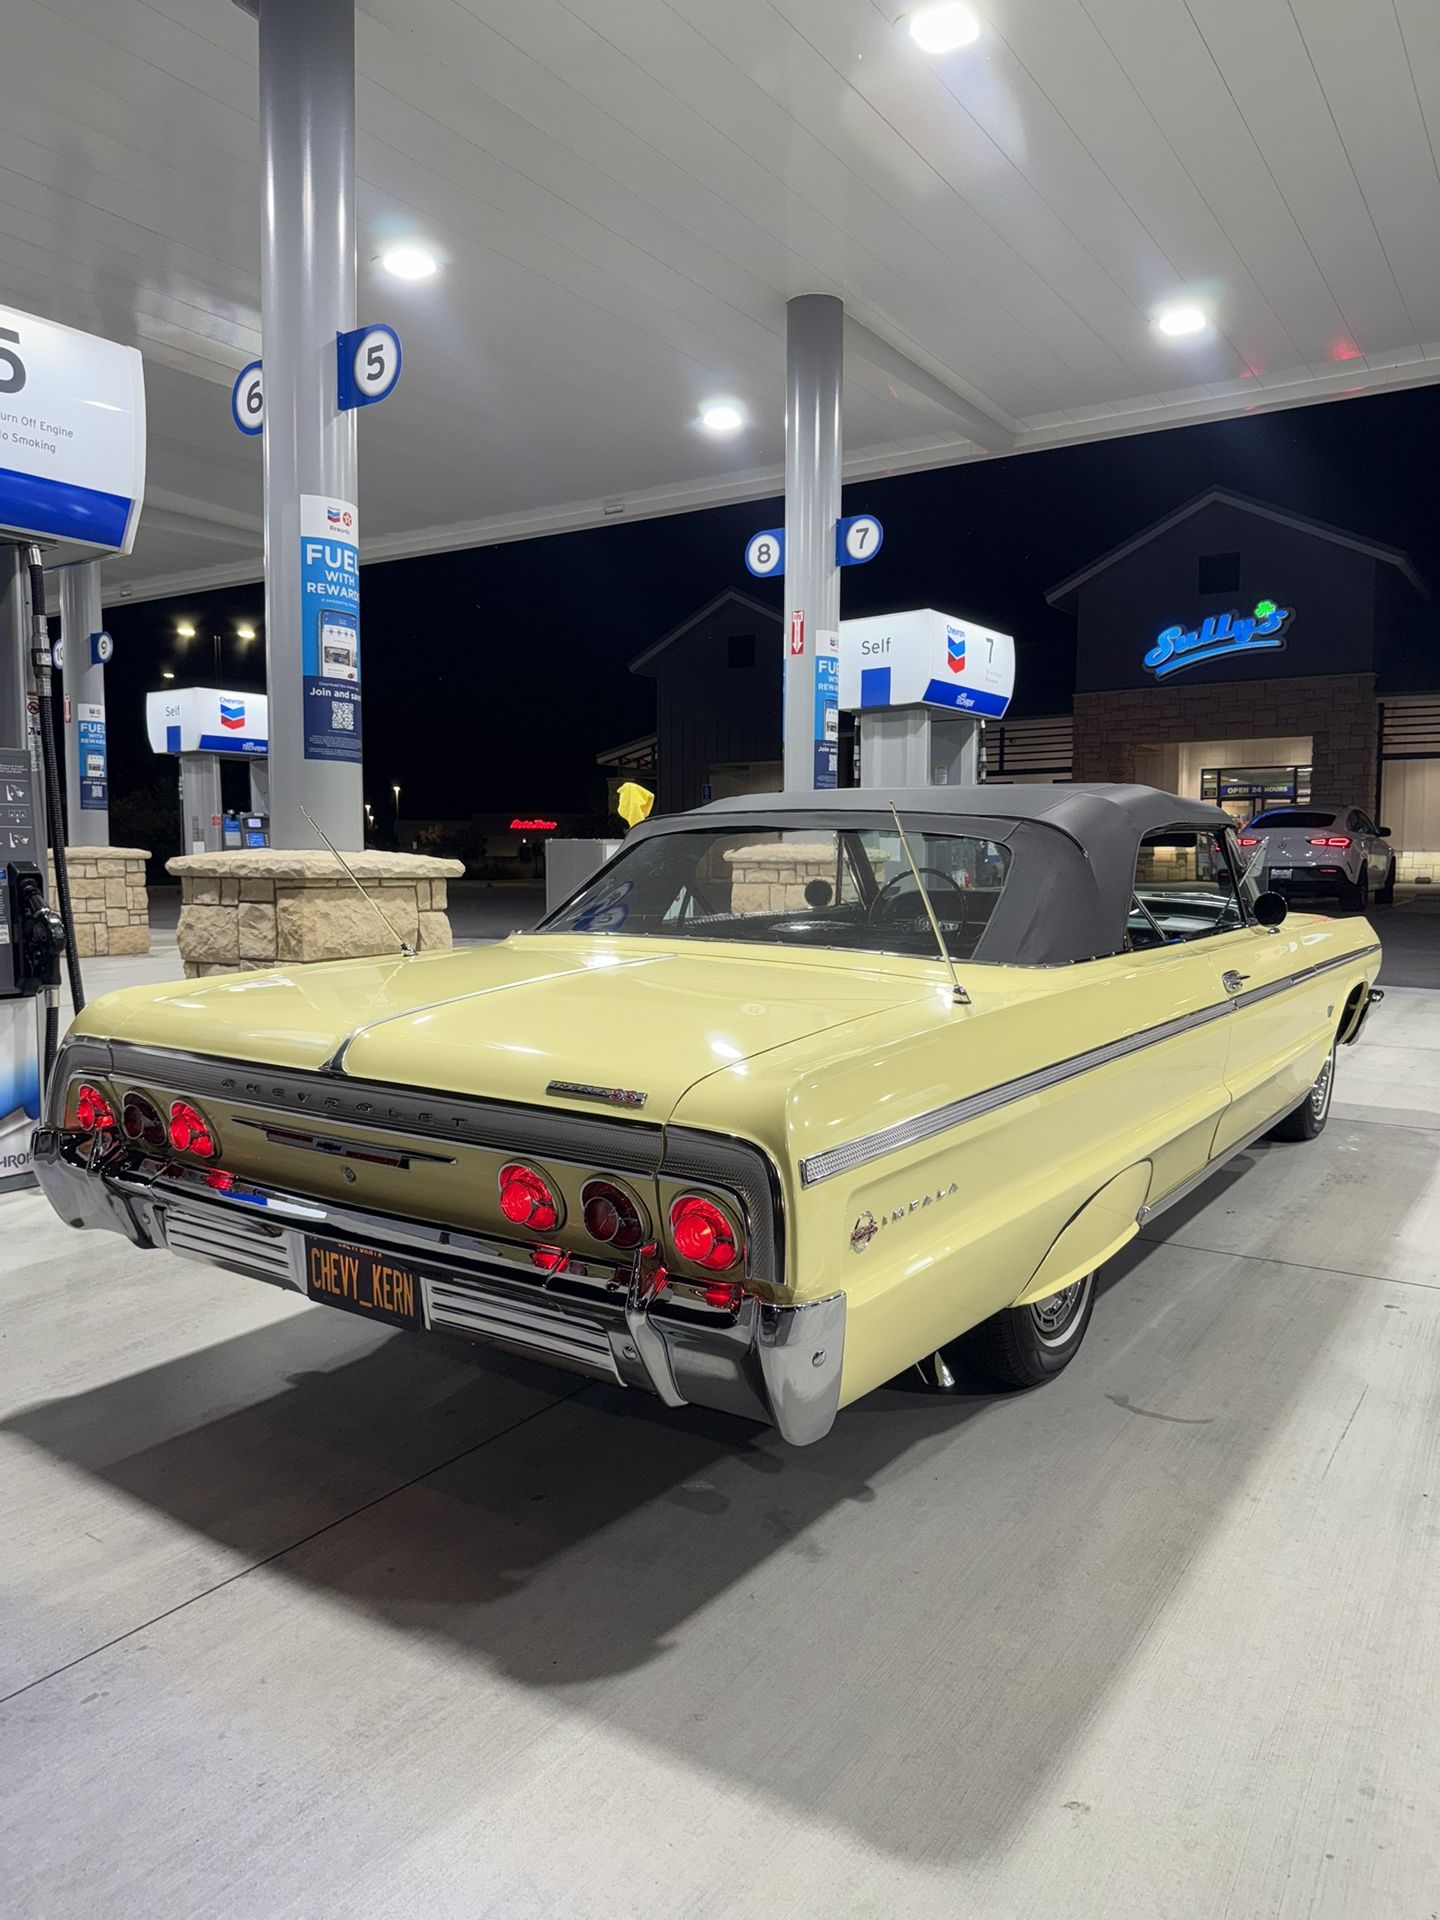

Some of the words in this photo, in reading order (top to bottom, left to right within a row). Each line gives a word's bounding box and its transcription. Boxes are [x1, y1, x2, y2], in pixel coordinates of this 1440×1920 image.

[366, 344, 385, 381] 5
[246, 380, 263, 414] 6
[0, 412, 18, 423] urn
[21, 416, 37, 429] Off
[40, 421, 74, 438] Engine
[12, 433, 56, 454] Smoking
[856, 527, 870, 549] 7
[757, 543, 771, 564] 8
[325, 570, 355, 587] WITH
[306, 582, 360, 602] REWARD
[861, 637, 891, 656] Self
[1144, 606, 1288, 667] Sully's
[101, 640, 107, 655] 9
[985, 637, 994, 663] 7
[219, 697, 245, 705] Chevron
[310, 687, 331, 696] Join
[334, 691, 349, 699] and
[165, 705, 180, 717] Self
[1227, 786, 1249, 794] OPEN
[510, 819, 557, 829] AutoZone
[220, 1078, 467, 1127] CHEVROLET
[610, 1088, 636, 1103] SS
[881, 1183, 959, 1230] IMPALA
